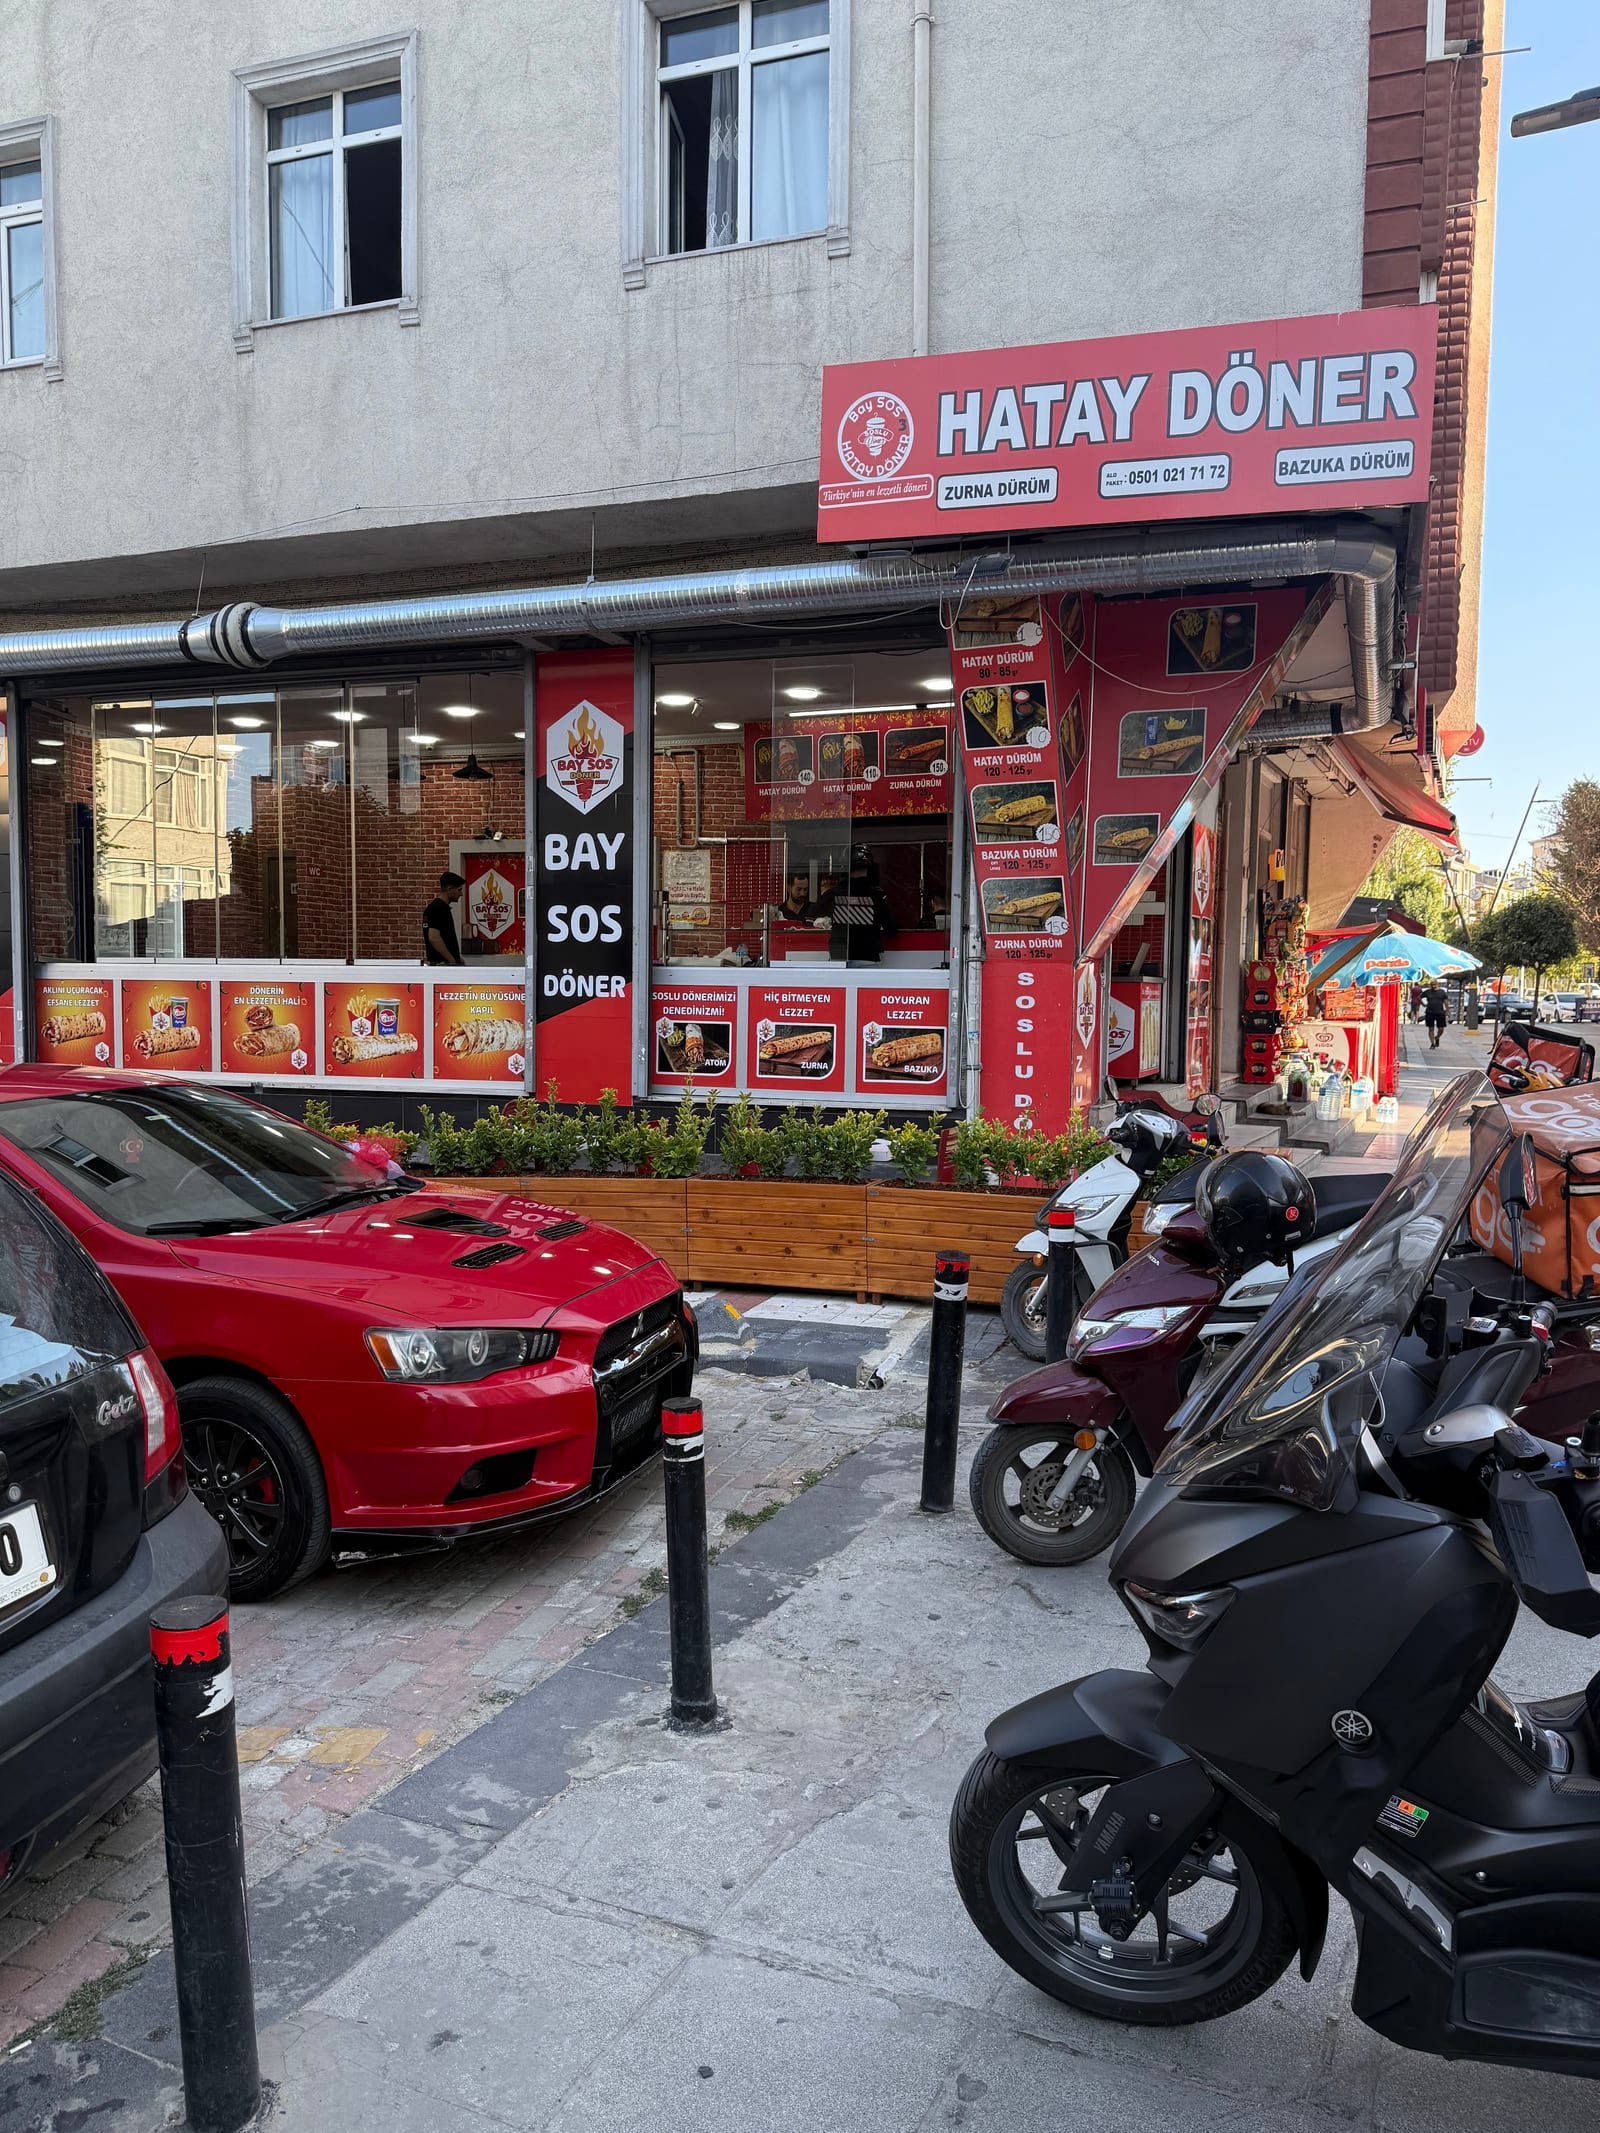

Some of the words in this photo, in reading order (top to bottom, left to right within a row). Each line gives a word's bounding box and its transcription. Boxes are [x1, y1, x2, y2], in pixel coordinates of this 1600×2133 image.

[937, 373, 1152, 457] HATAY
[1167, 349, 1419, 438] DÖNER
[848, 400, 873, 423] Bay
[877, 397, 903, 417] SOS
[899, 419, 907, 431] 3
[842, 440, 873, 476] HATAY
[876, 434, 910, 476] DÖNER
[1278, 456, 1345, 477] BAZUKA
[1350, 450, 1410, 472] DÜRÜM
[1163, 467, 1185, 483] 021
[1190, 466, 1205, 481] 71
[1210, 464, 1225, 479] 72
[823, 487, 865, 503] Türkiye'nin
[866, 489, 875, 497] en
[877, 484, 902, 496] lezzetli
[903, 481, 928, 493] döneri
[944, 484, 993, 500] ZURNA
[998, 476, 1050, 496] DÜRÜM
[962, 655, 994, 668] HATAY
[997, 651, 1034, 665] DÜRÜM
[979, 668, 990, 678] 80
[999, 666, 1011, 677] 85
[557, 760, 584, 771] BAY
[588, 759, 613, 770] SOS
[973, 755, 1003, 766] HATAY
[1006, 752, 1041, 764] DÜRÜM
[984, 766, 1000, 776] 120
[1008, 765, 1025, 775] 125
[823, 784, 844, 793] HATAY
[847, 783, 872, 792] DÜRÜM
[889, 781, 914, 790] ZURNA
[916, 779, 942, 788] DÜRÜM
[759, 788, 780, 796] HATAY
[782, 786, 806, 795] DÜRÜM
[544, 832, 625, 871] BAY
[981, 850, 1020, 860] BAZUKA
[1023, 847, 1058, 858] DÜRÜM
[1003, 860, 1019, 870] 120
[1027, 860, 1044, 869] 125
[476, 905, 491, 913] BAY
[494, 905, 509, 913] SOS
[547, 904, 623, 943] SOS
[995, 940, 1026, 949] ZURNA
[1029, 938, 1062, 949] DÜRÜM
[1005, 950, 1021, 959] 120
[1030, 949, 1045, 958] 125
[250, 984, 284, 995] DÖNERİN
[544, 969, 626, 998] DÖNER
[42, 986, 65, 994] AKLINI
[66, 986, 103, 996] UÇURACAK
[439, 990, 478, 1001] LEZZETİN
[480, 991, 525, 1001] BÜYÜSÜNE
[652, 991, 680, 1001] SOSLU
[682, 990, 736, 1002] DÖNERİMİZİ
[47, 999, 72, 1007] EFSANE
[74, 999, 99, 1007] LEZZET
[246, 996, 281, 1005] LEZZETLİ
[282, 996, 300, 1005] HALİ
[764, 991, 779, 1004] HİÇ
[782, 992, 831, 1003] BİTMEYEN
[881, 995, 930, 1006] DOYURAN
[663, 1004, 725, 1016] DENEDİNİZMİ!
[779, 1008, 814, 1017] LEZZET
[887, 1010, 923, 1020] LEZZET
[1109, 1030, 1125, 1039] OS
[704, 1059, 726, 1067] ATOM
[801, 1062, 828, 1070] ZURNA
[904, 1065, 938, 1074] BAZUKA
[97, 1394, 137, 1426] Getz
[1093, 1811, 1126, 1855] YAMAHA
[1204, 1966, 1260, 2009] MICHELIN
